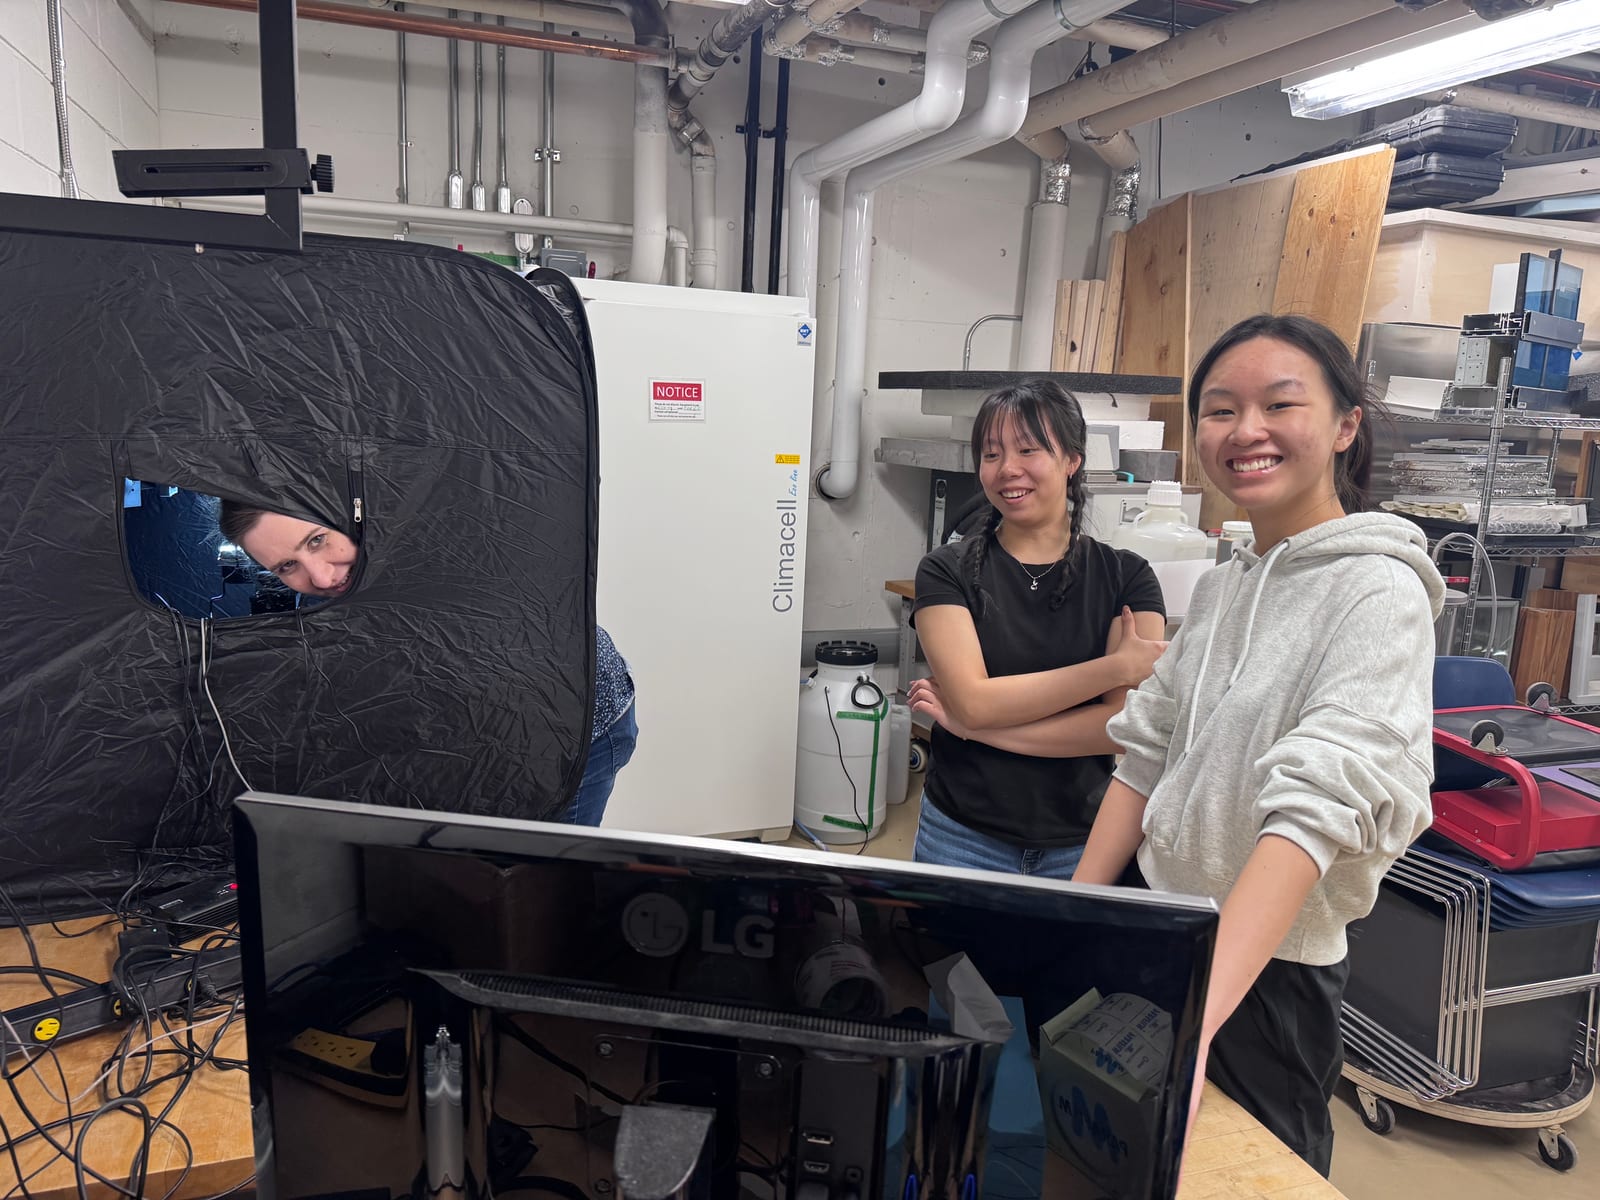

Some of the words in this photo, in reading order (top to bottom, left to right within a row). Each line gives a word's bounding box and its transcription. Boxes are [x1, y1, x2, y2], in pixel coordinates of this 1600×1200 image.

[656, 386, 699, 398] NOTICE
[772, 500, 797, 613] Climacell
[702, 909, 776, 959] LG
